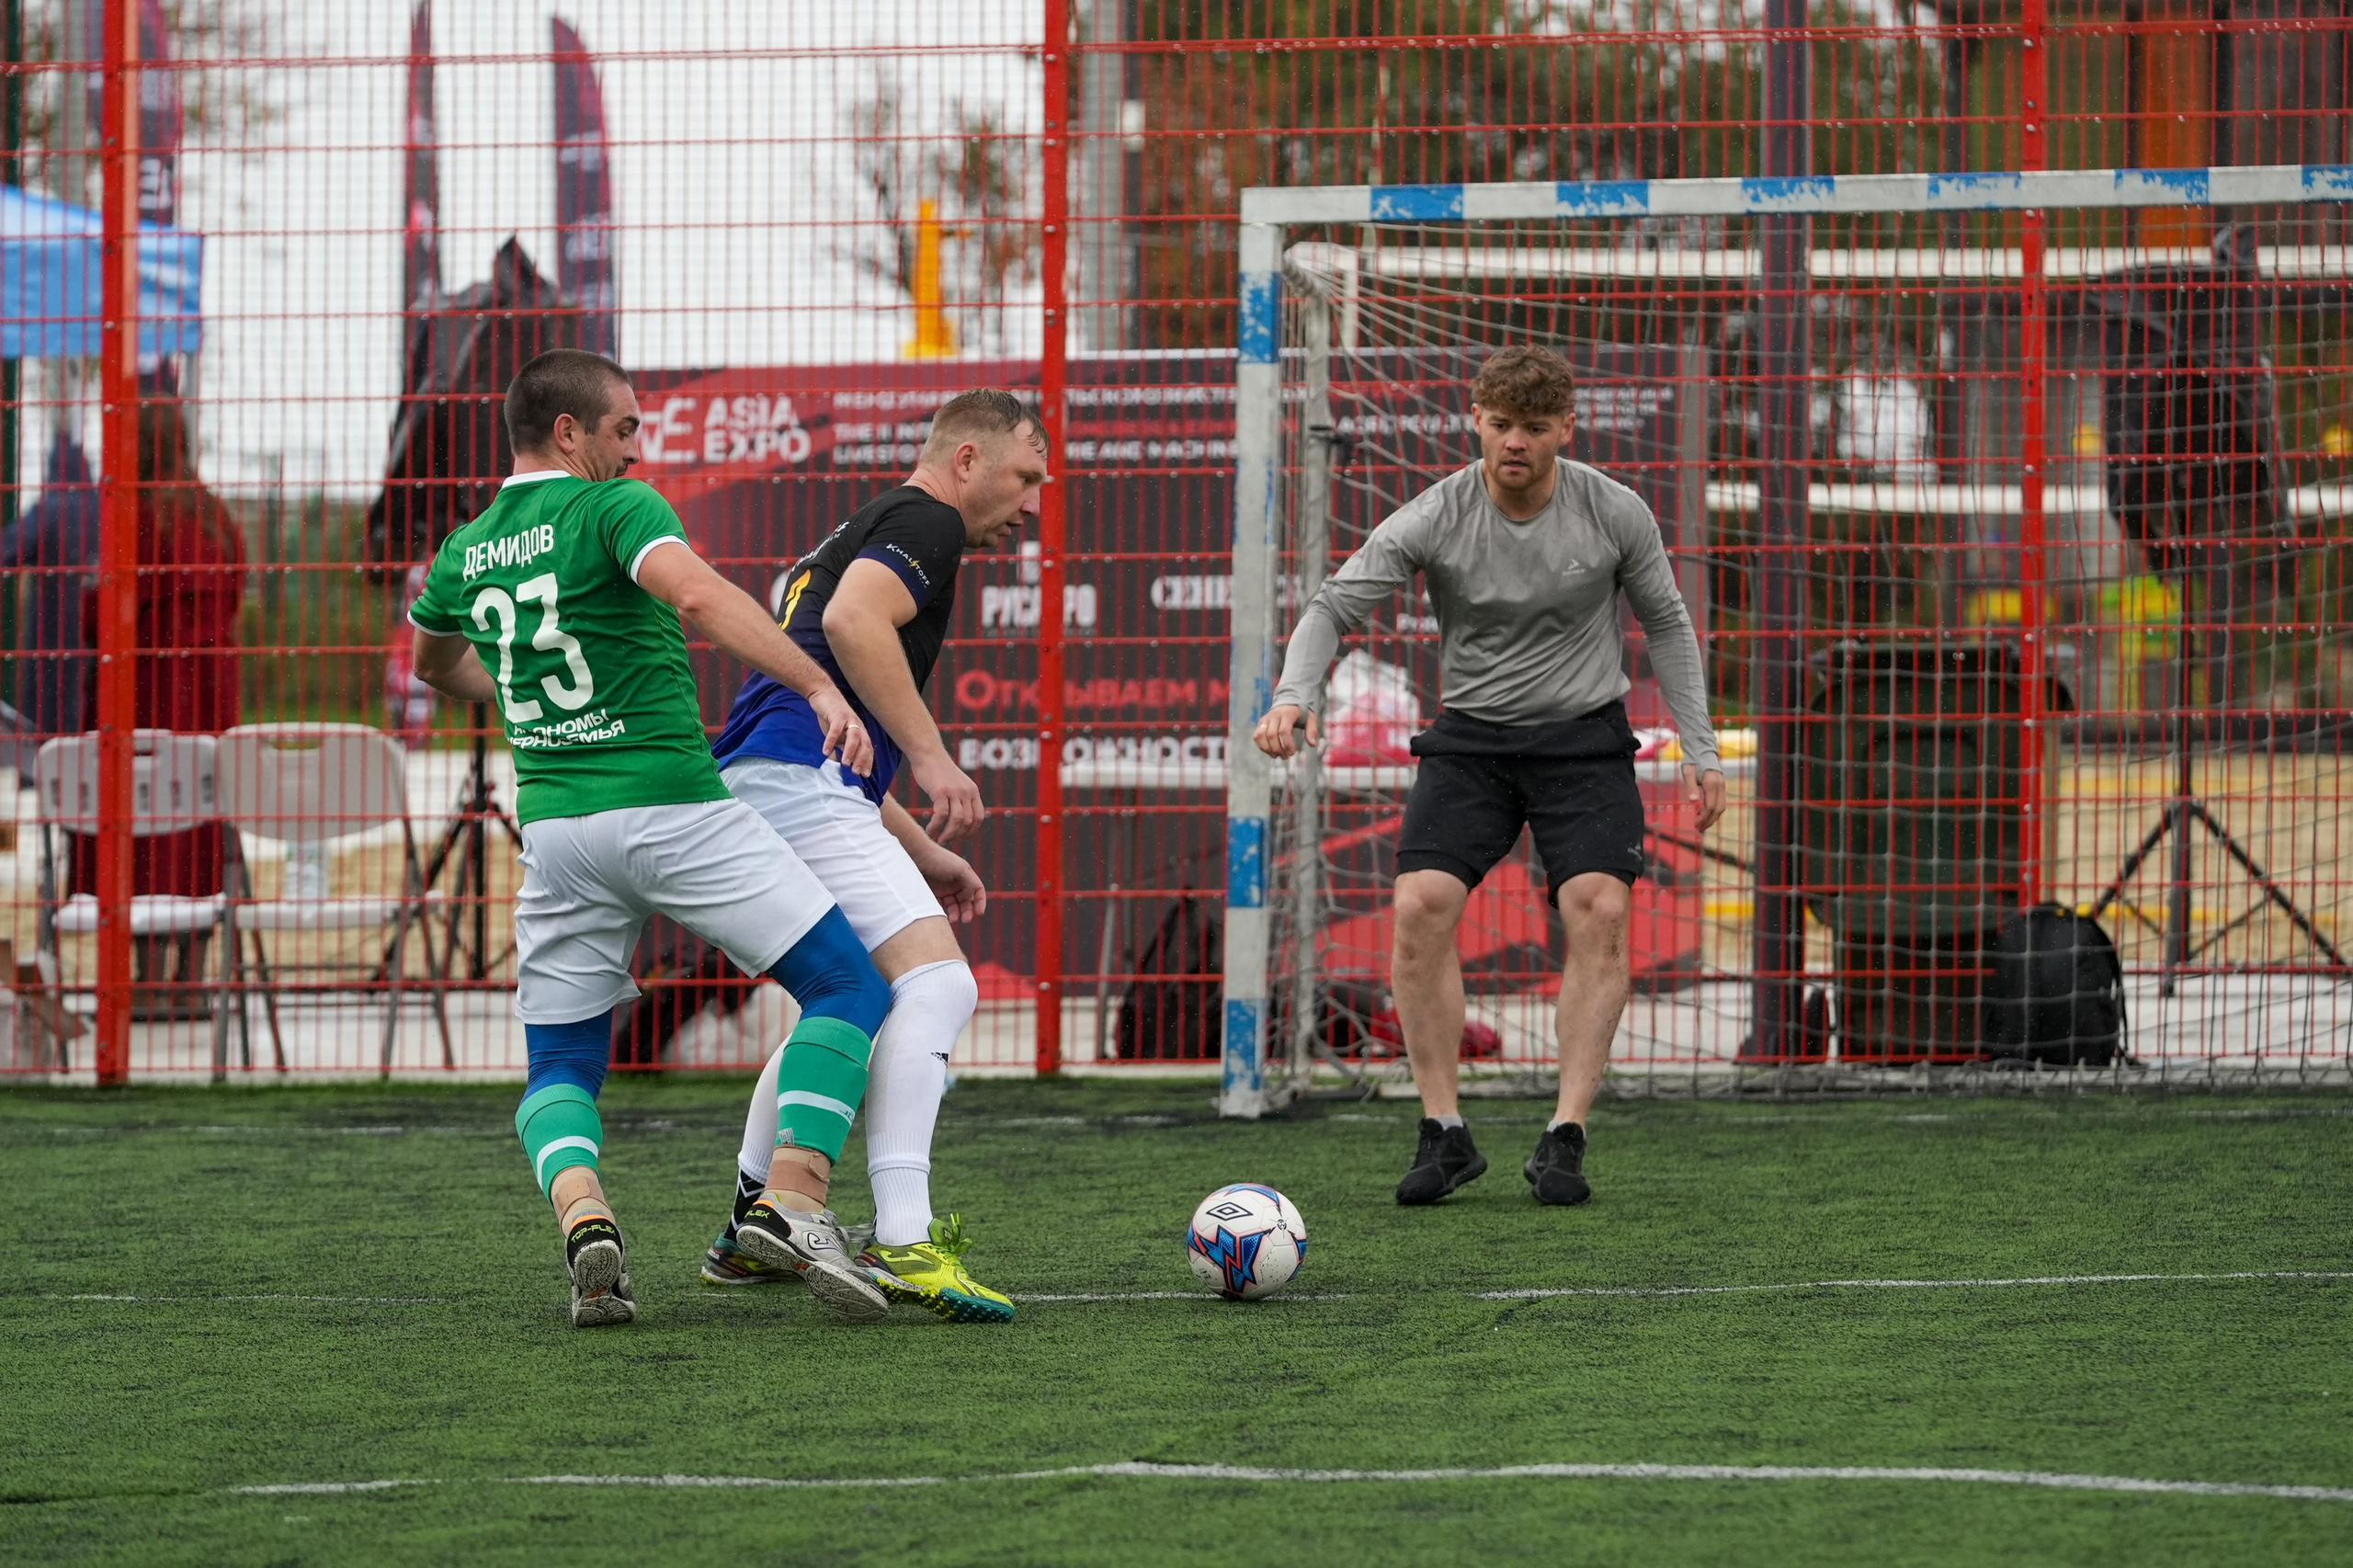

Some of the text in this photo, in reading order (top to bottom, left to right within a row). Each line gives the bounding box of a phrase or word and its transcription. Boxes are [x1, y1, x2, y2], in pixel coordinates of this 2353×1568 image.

[704, 396, 800, 429] ASIA
[703, 428, 813, 464] EXPO
[462, 524, 554, 582] ДЕМИДОВ
[981, 584, 1097, 630] РУСАРО
[471, 572, 595, 724] 23
[514, 708, 610, 737] ОНОМЫ
[959, 737, 1230, 770] ВОЗОЖНОСТ
